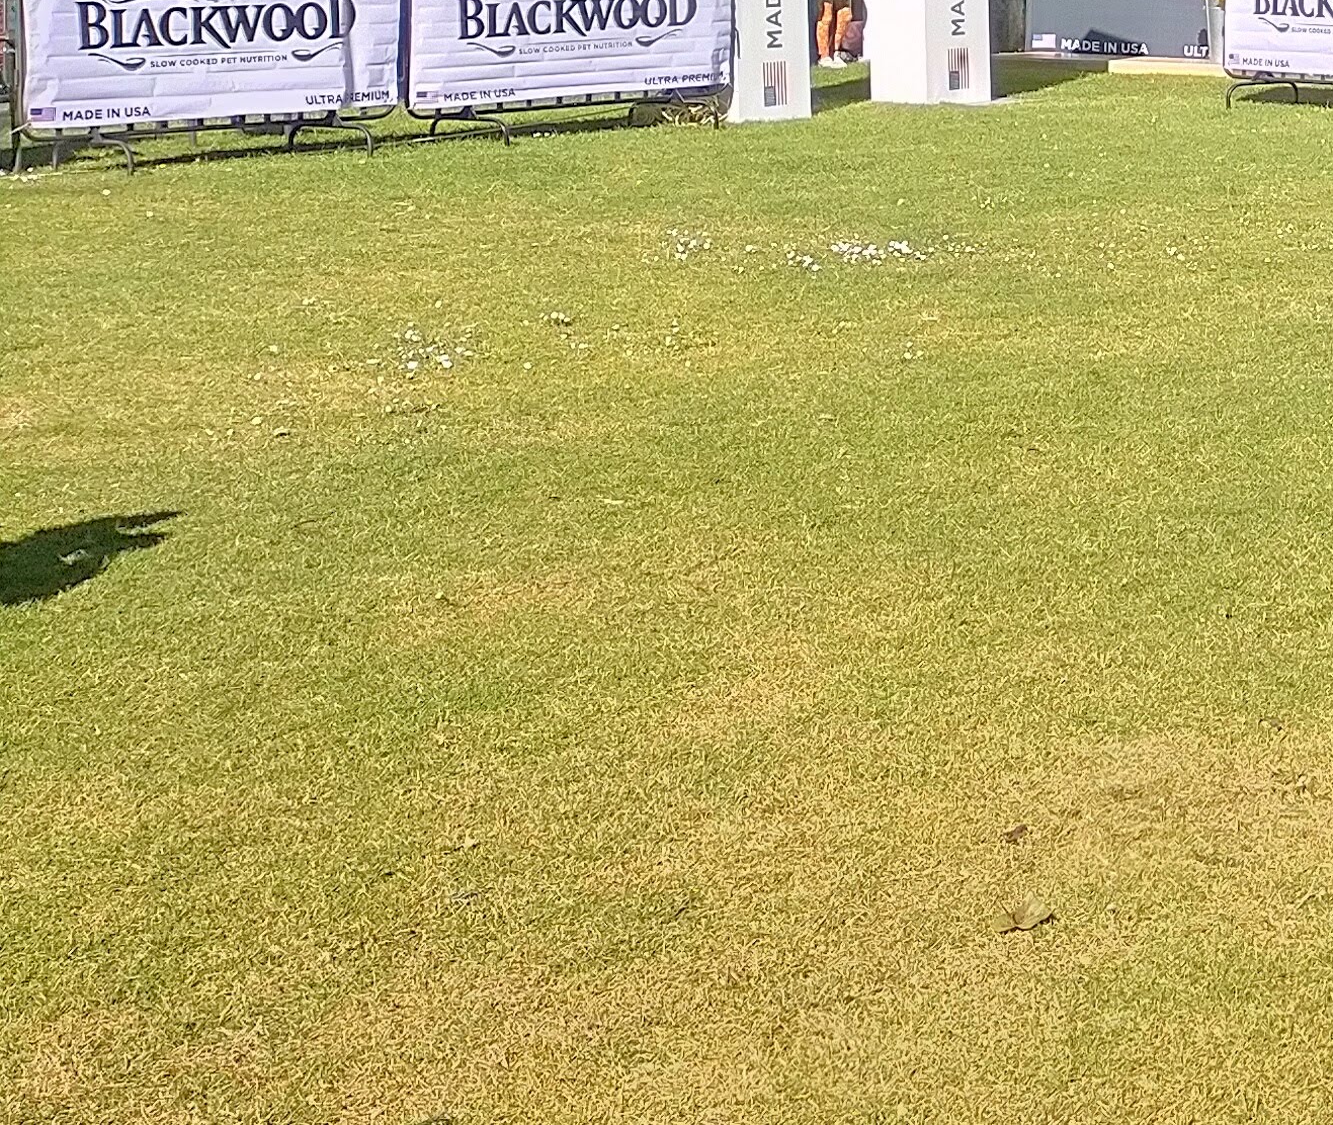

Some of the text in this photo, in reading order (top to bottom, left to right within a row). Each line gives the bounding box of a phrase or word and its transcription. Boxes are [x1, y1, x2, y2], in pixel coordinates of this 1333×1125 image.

[1060, 38, 1149, 55] MADE IN USA
[1183, 45, 1209, 57] ULT
[150, 55, 288, 68] SLOW COOKED PET NUTRITION
[1242, 57, 1290, 68] MADE IN USA
[644, 75, 678, 86] ULTRA
[305, 94, 343, 105] ULTRA
[443, 88, 516, 103] MADE IN USA
[62, 106, 151, 121] MADE IN USA
